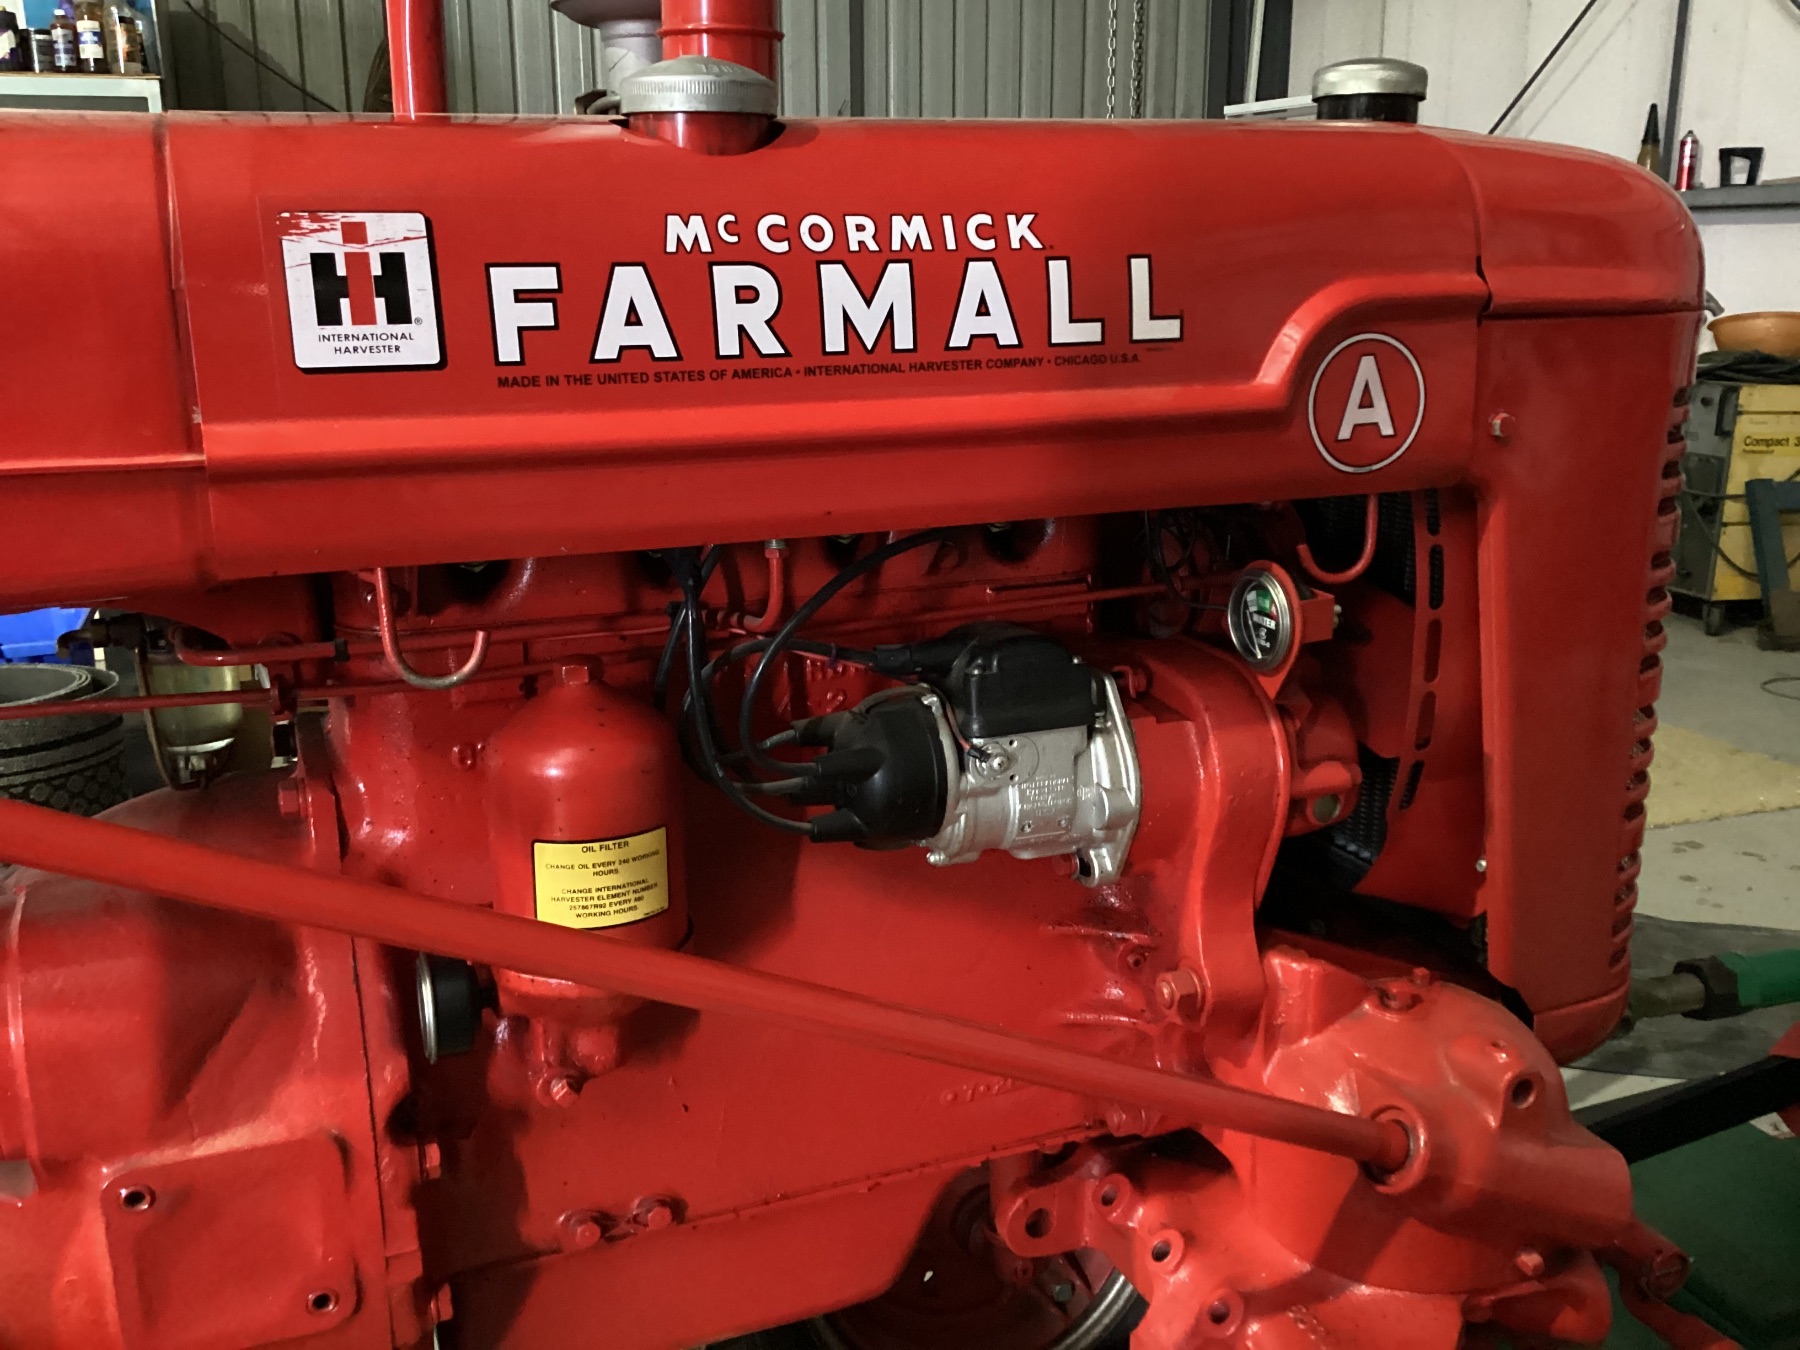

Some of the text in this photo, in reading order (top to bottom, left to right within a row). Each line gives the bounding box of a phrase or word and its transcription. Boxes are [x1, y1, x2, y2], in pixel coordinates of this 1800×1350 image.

[485, 254, 1184, 367] FARMALL
[318, 332, 415, 343] INTERNATIONAL
[334, 344, 402, 355] HARVESTER
[497, 375, 541, 388] MADE
[545, 375, 560, 387] IN
[564, 373, 593, 386] THE
[598, 371, 650, 385] UNITED
[653, 369, 706, 383] STATES
[709, 368, 728, 381] OF
[731, 366, 793, 380] AMERICA
[803, 363, 906, 377] INTERNATIONAL
[909, 359, 983, 373] HARVESTER
[985, 356, 1044, 369] COMPANY
[1054, 354, 1108, 367] CHICAGO
[1336, 354, 1395, 441] A
[1743, 435, 1790, 448] Compact
[581, 840, 630, 854] OIL FILTER
[545, 863, 576, 871] CHANGE
[592, 860, 616, 870] EVERY
[592, 867, 620, 877] HOURS
[550, 882, 659, 903] HARVESTER ELEMENT NUMBER
[594, 877, 650, 894] INTERNATIONAL
[608, 898, 632, 908] EVERY
[575, 910, 612, 919] WORKING
[613, 904, 639, 915] HOURS
